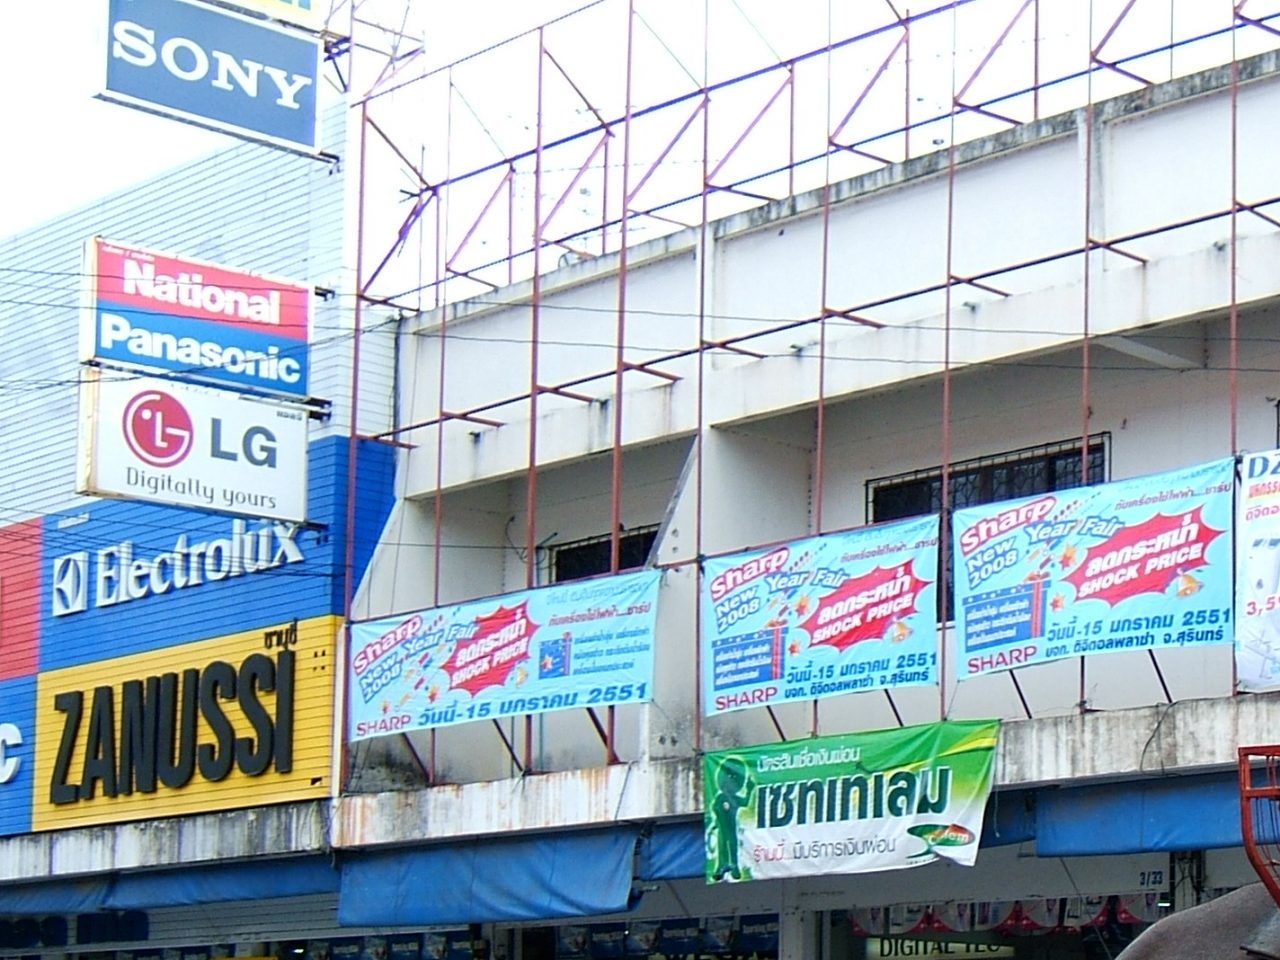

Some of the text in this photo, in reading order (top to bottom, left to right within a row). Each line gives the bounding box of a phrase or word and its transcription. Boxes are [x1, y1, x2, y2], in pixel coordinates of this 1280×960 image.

[113, 21, 312, 110] SONY
[123, 261, 280, 324] National
[102, 313, 300, 384] Panasonic
[211, 417, 277, 468] LG
[127, 467, 276, 508] Digitally yours
[960, 496, 1057, 556] Sharp
[966, 516, 1124, 573] New Year Fair
[95, 519, 304, 607] Electrolux
[711, 547, 789, 602] Sharp
[970, 549, 1019, 590] 2008
[1079, 543, 1203, 597] SHOCK PRICE
[715, 568, 849, 618] New Year Fair
[718, 598, 760, 633] 2008
[812, 593, 914, 644] SHOCK PRICE
[1110, 614, 1174, 633] มกราคม
[1182, 608, 1230, 626] 2551
[354, 615, 422, 675] Sharp
[360, 623, 479, 688] New Year Fair
[452, 637, 528, 687] SHOCK PRICE
[840, 658, 890, 676] มกราคม
[896, 652, 936, 668] 2551
[968, 646, 1037, 673] SHARP
[363, 663, 402, 702] 2008
[500, 692, 578, 713] มกราคม
[587, 682, 648, 703] 2551
[715, 687, 777, 710] SHARP
[49, 651, 296, 805] ZANUSSI
[357, 715, 411, 736] SHARP
[880, 937, 954, 957] DIGITAL
